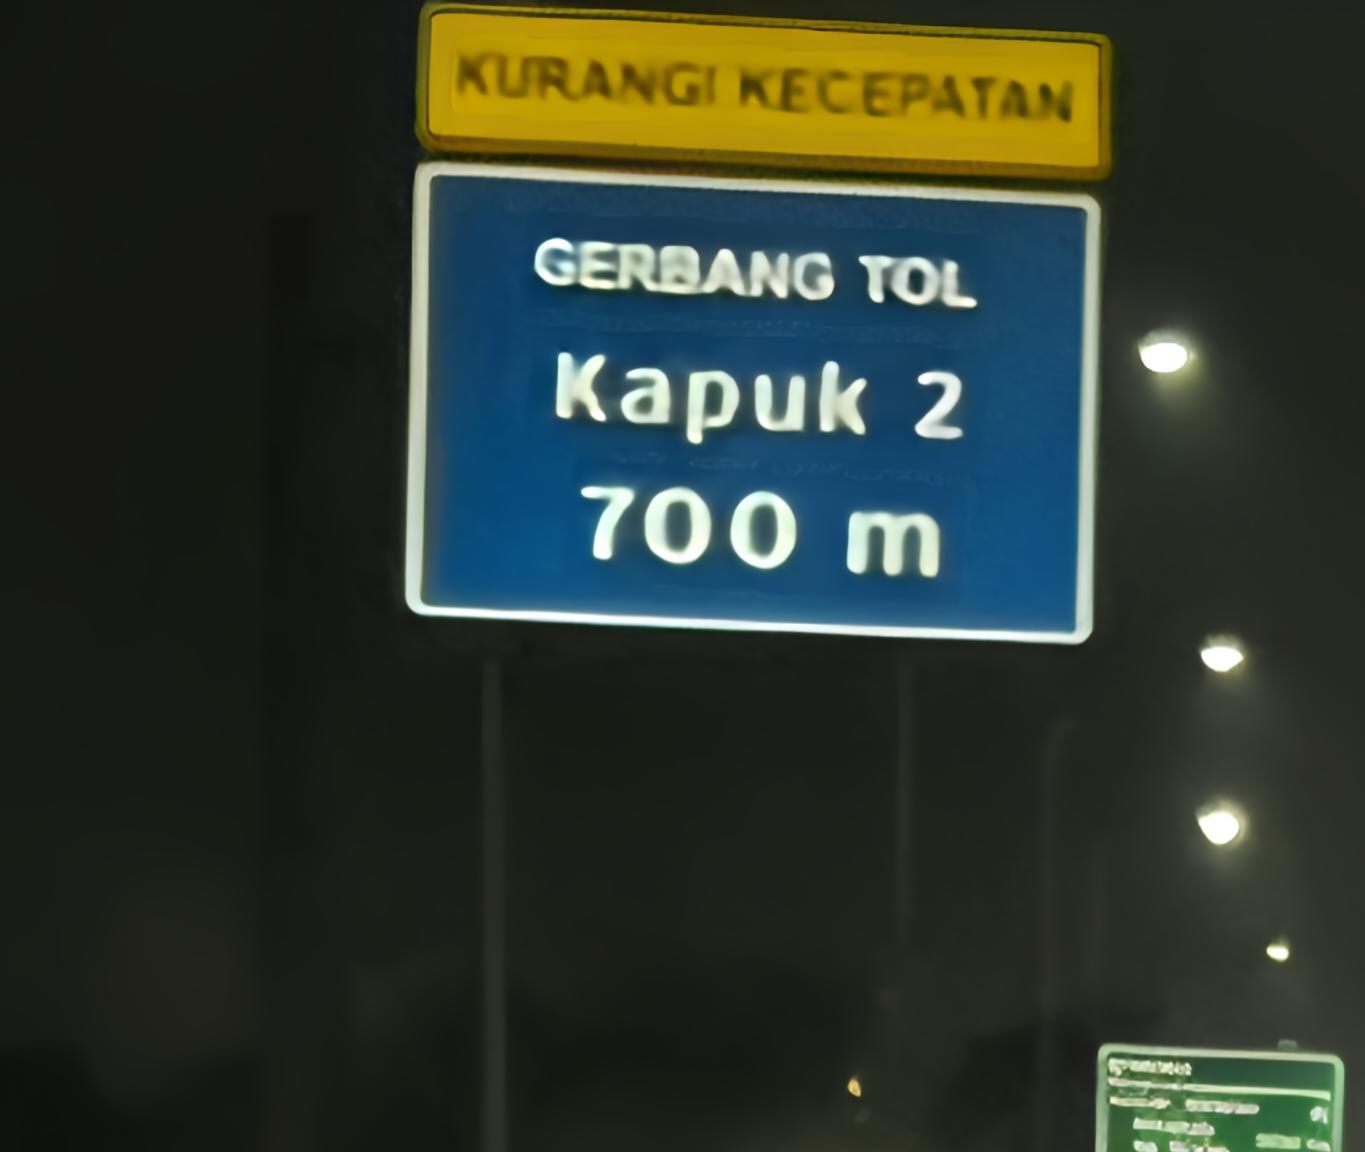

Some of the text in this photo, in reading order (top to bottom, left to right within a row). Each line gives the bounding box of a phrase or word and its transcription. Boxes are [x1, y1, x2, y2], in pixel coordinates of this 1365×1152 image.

[456, 53, 1074, 123] KURANGI KECEPATAN
[534, 238, 978, 309] GERBANG TOL
[555, 351, 965, 444] Kapuk 2
[580, 485, 940, 578] 700 m
